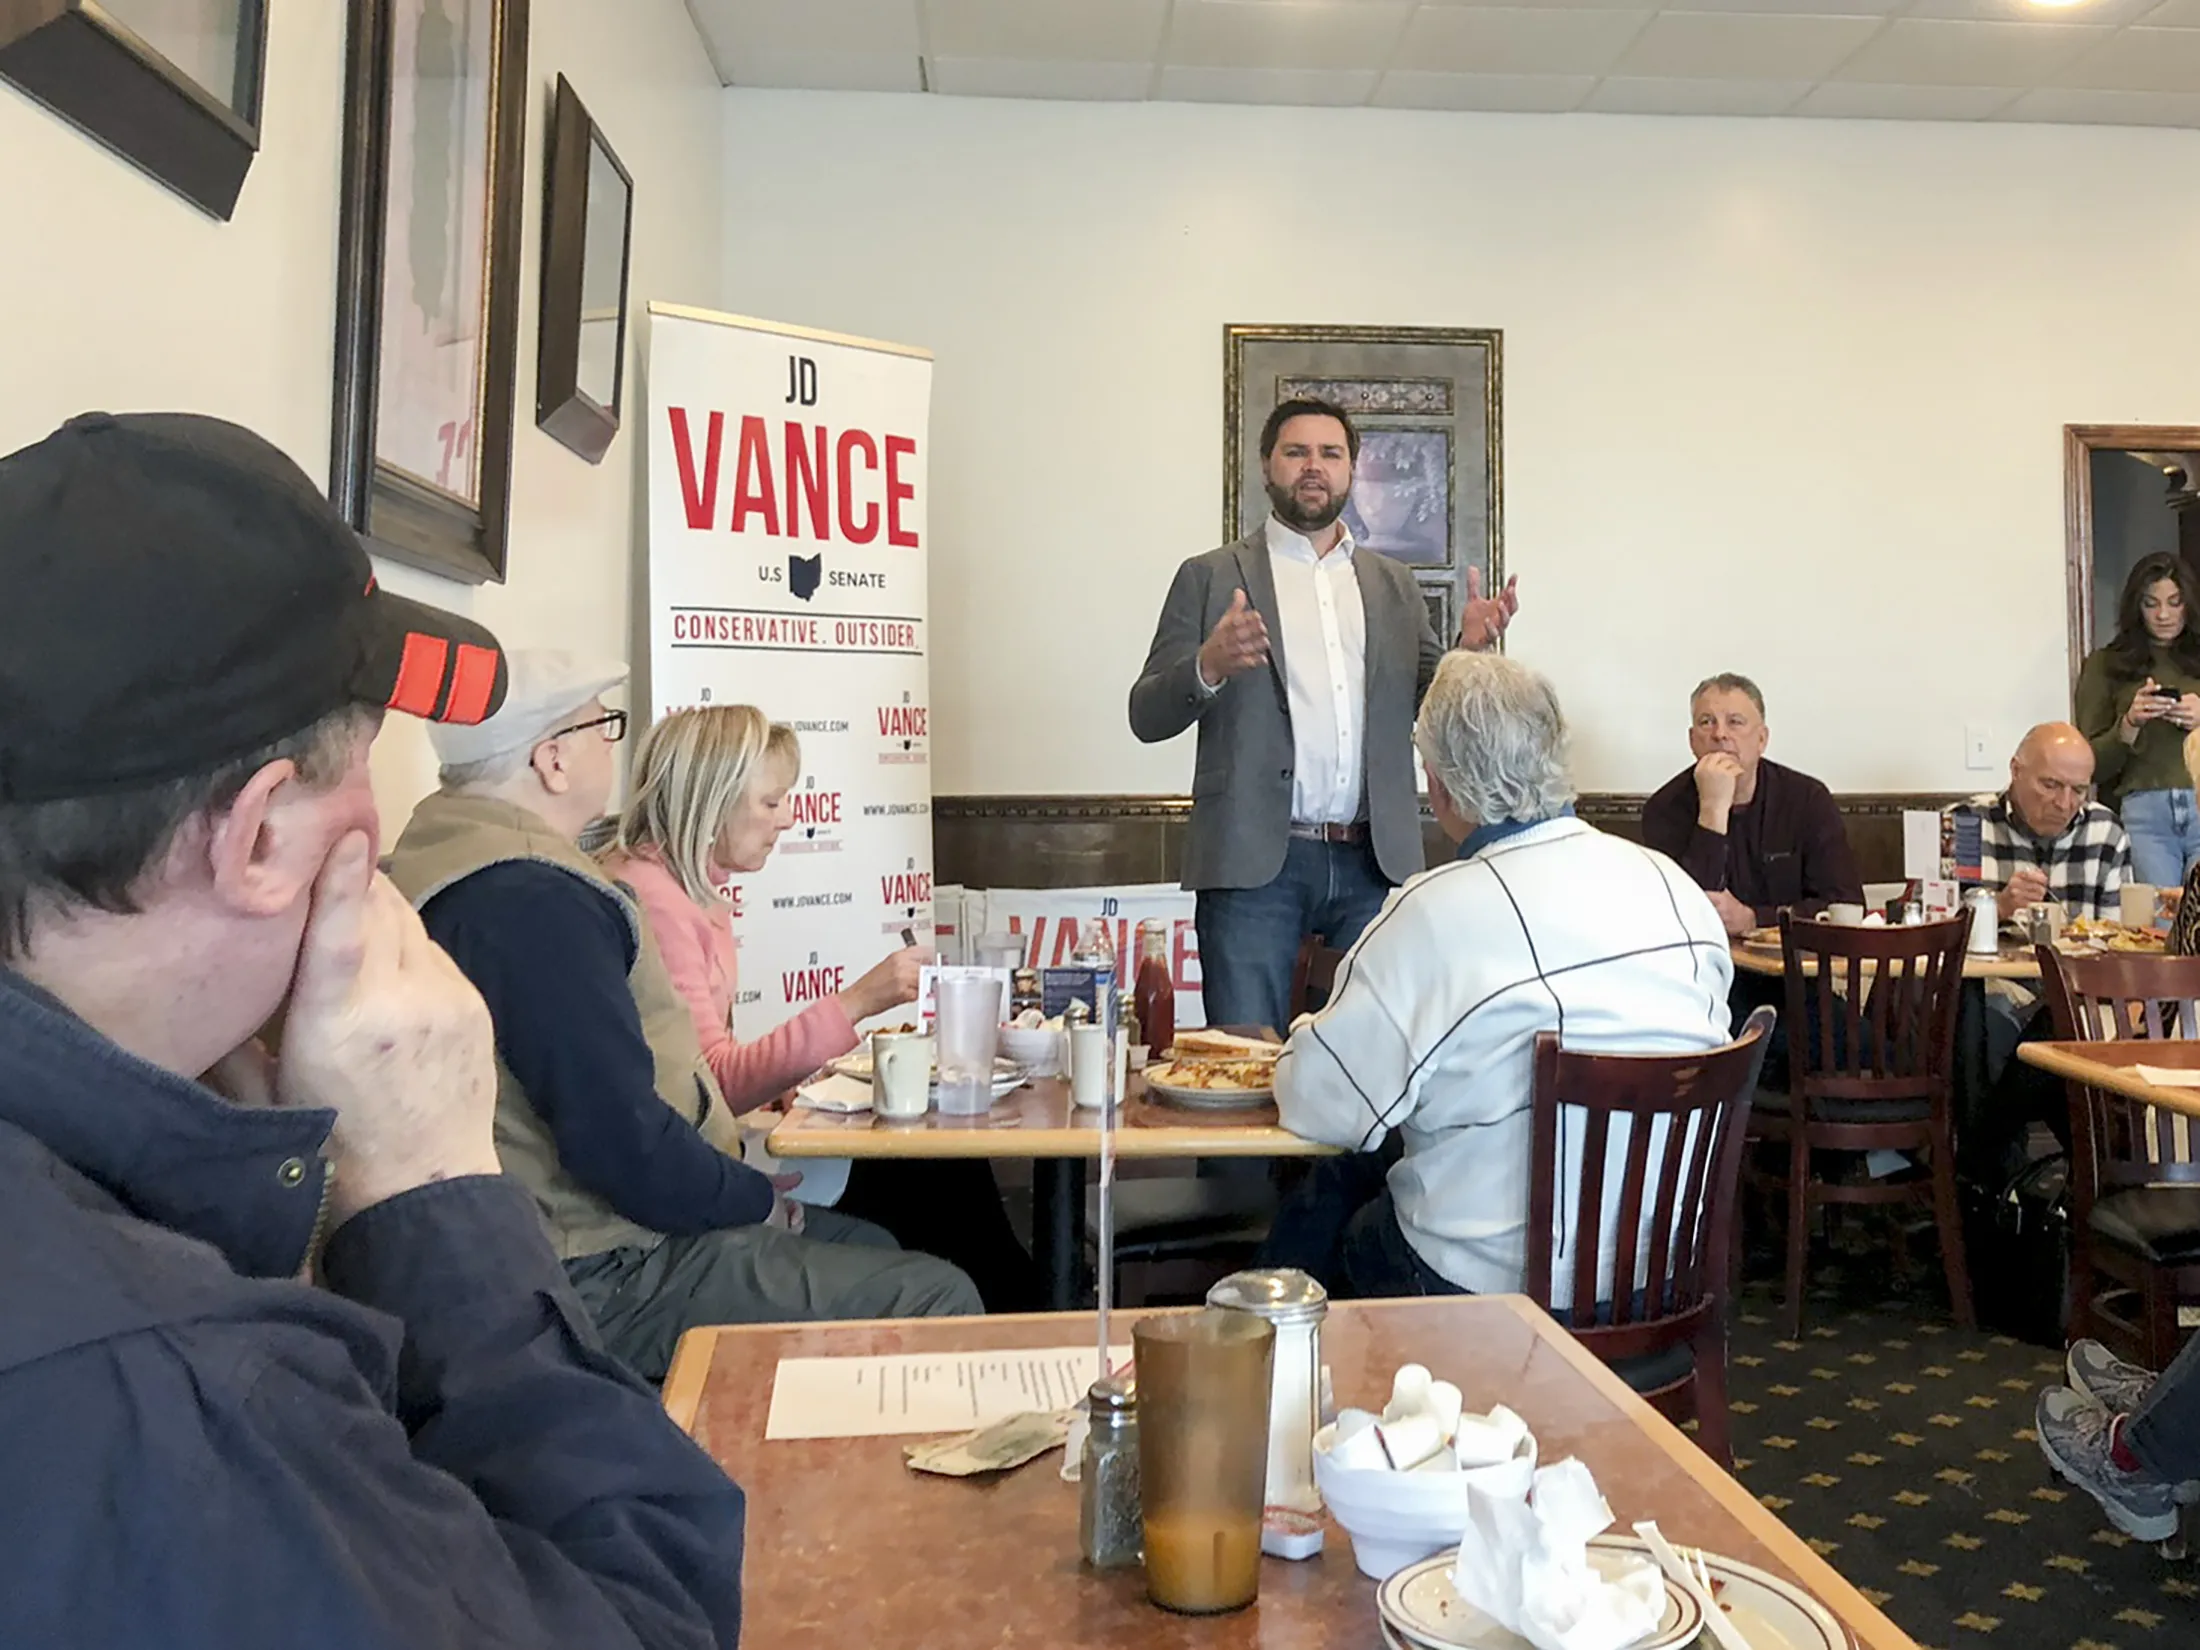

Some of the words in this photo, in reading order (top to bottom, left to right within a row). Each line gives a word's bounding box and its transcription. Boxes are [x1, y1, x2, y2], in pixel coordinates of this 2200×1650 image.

[785, 355, 818, 406] JD
[667, 406, 919, 549] VANCE
[828, 571, 886, 589] SENATE
[674, 614, 827, 645] CONSERVATIVE.
[877, 706, 928, 737] VANCE
[787, 792, 842, 824] ANCE
[881, 872, 932, 905] VANCE
[1100, 898, 1119, 917] JD
[782, 965, 845, 1003] VANCE
